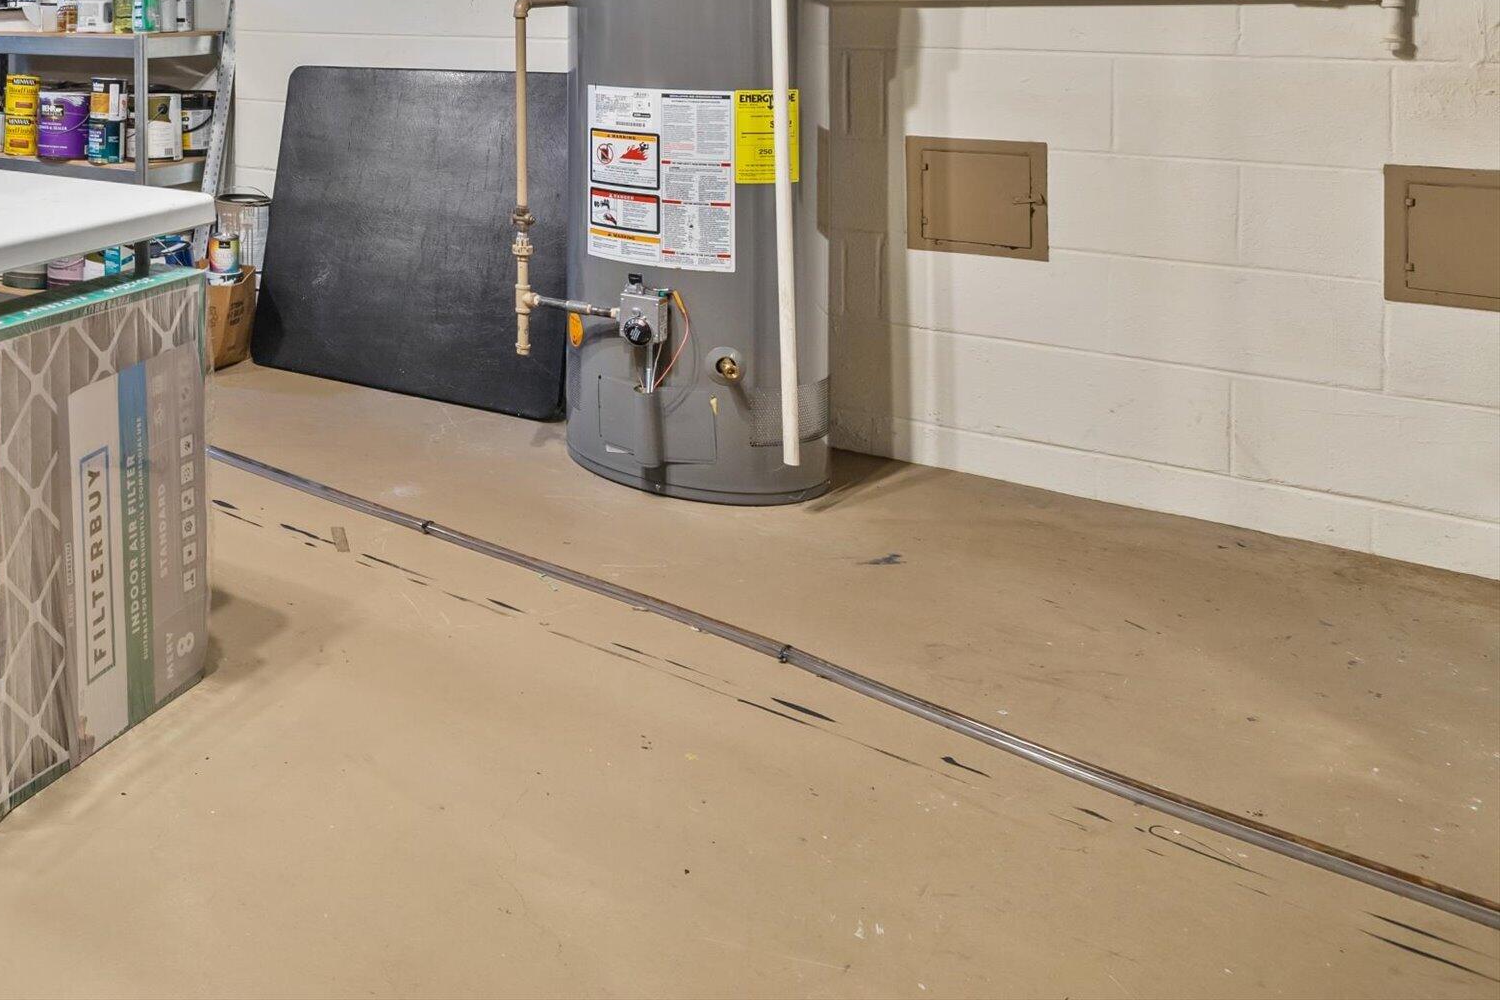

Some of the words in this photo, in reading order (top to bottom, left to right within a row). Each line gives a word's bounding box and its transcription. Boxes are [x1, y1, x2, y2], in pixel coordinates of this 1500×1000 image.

[126, 454, 139, 517] FILTER
[128, 519, 140, 552] AIR
[158, 483, 168, 580] STANDARD
[87, 468, 107, 666] FILTERBUY
[129, 556, 141, 635] INDOOR
[141, 618, 149, 660] SUITABLE
[165, 632, 175, 681] MERV
[177, 631, 195, 658] 8
